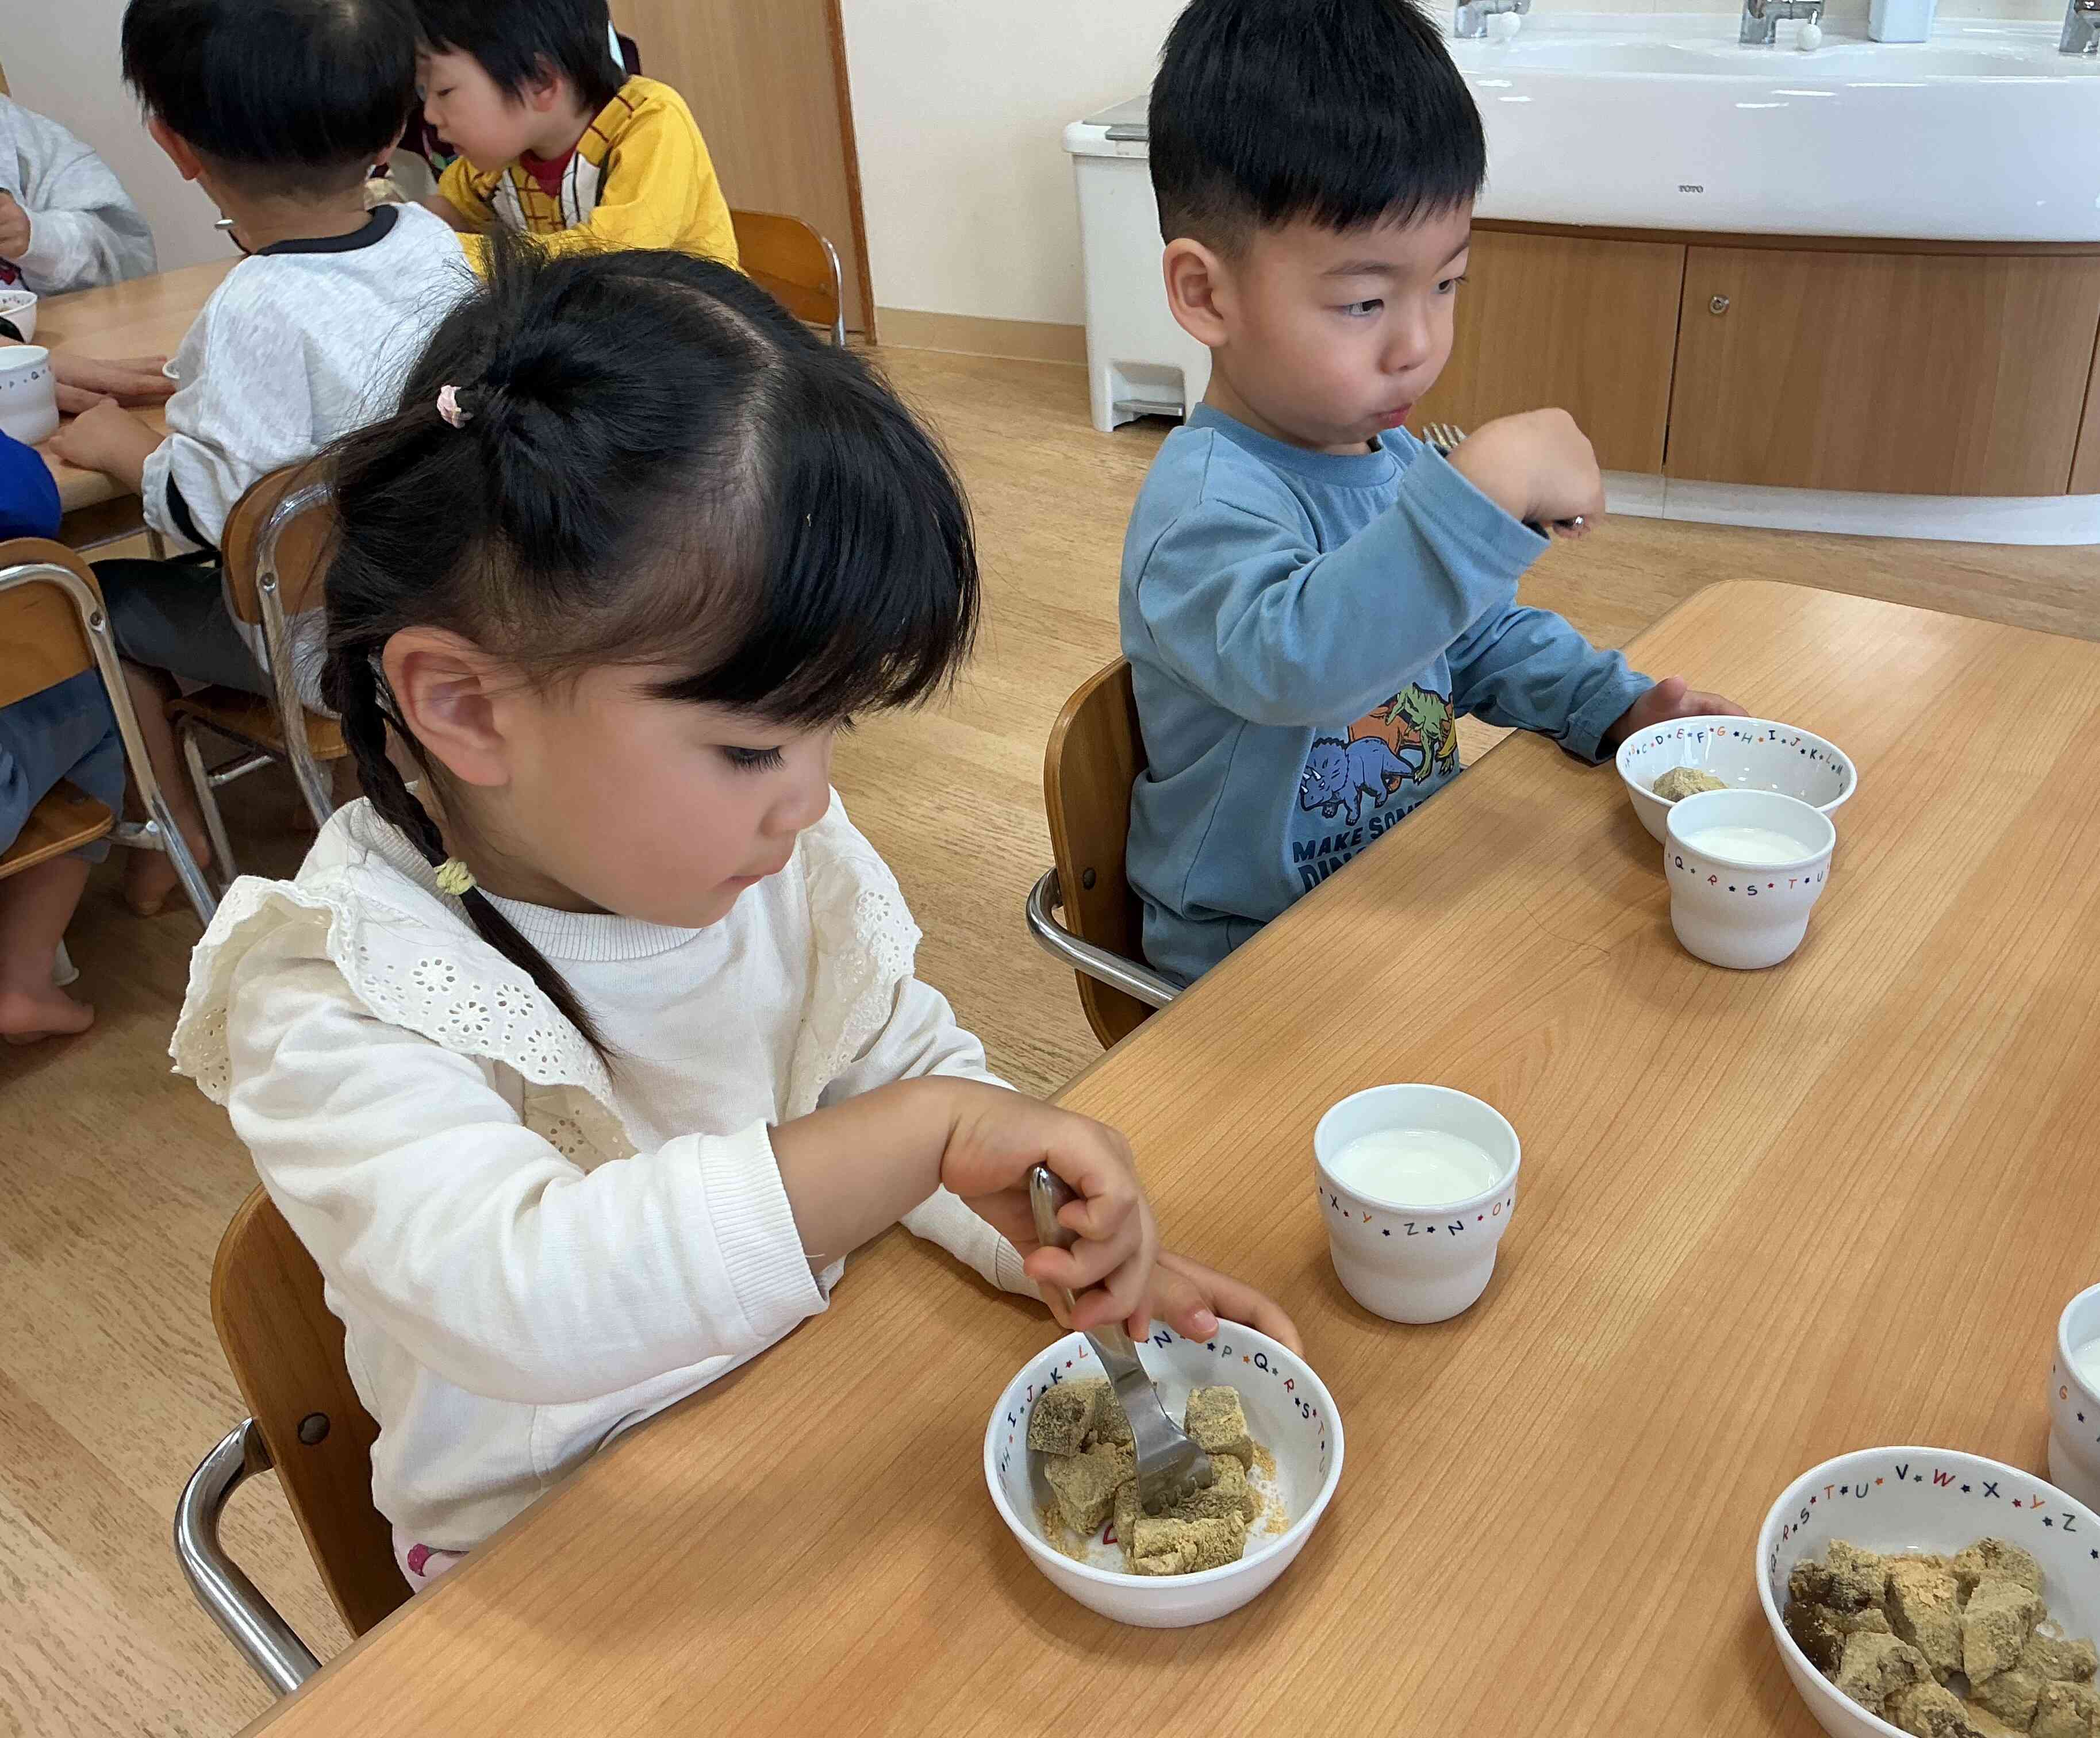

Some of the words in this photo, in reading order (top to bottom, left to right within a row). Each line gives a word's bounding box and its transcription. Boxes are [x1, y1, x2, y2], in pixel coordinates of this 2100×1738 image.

[1678, 184, 1704, 193] TOTO
[1641, 743, 1647, 754] C
[1655, 735, 1664, 745] D
[1676, 728, 1684, 740] E
[1696, 732, 1704, 744] F
[1717, 726, 1726, 737] G
[1741, 732, 1753, 744] H
[1768, 730, 1776, 740] I
[1790, 737, 1801, 747] J
[1810, 748, 1818, 760] K
[1292, 826, 1364, 863] MAKE
[1675, 856, 1684, 870] Q
[1707, 874, 1717, 886] R
[1747, 885, 1758, 896] S
[1788, 879, 1798, 890] T
[1817, 871, 1823, 883] U
[1330, 1194, 1339, 1210] X
[1362, 1211, 1372, 1224] Y
[1403, 1222, 1419, 1236] Z
[1448, 1220, 1464, 1236] N
[1492, 1202, 1502, 1217] O
[1003, 1446, 1011, 1467] H
[1007, 1412, 1016, 1428] I
[1027, 1386, 1034, 1402] J
[1050, 1367, 1063, 1385] K
[1078, 1344, 1088, 1359] L
[1153, 1330, 1172, 1349] N
[1221, 1345, 1233, 1358] P
[1254, 1352, 1269, 1372] Q
[1283, 1378, 1295, 1393] R
[1302, 1402, 1310, 1419] S
[1782, 1524, 1789, 1542] R
[1800, 1508, 1810, 1525] S
[1823, 1484, 1836, 1500] T
[1855, 1482, 1869, 1498] U
[1895, 1464, 1909, 1480] V
[1933, 1468, 1956, 1487] W
[1983, 1482, 2000, 1498] X
[2029, 1494, 2045, 1509] Y
[2062, 1513, 2076, 1532] Z
